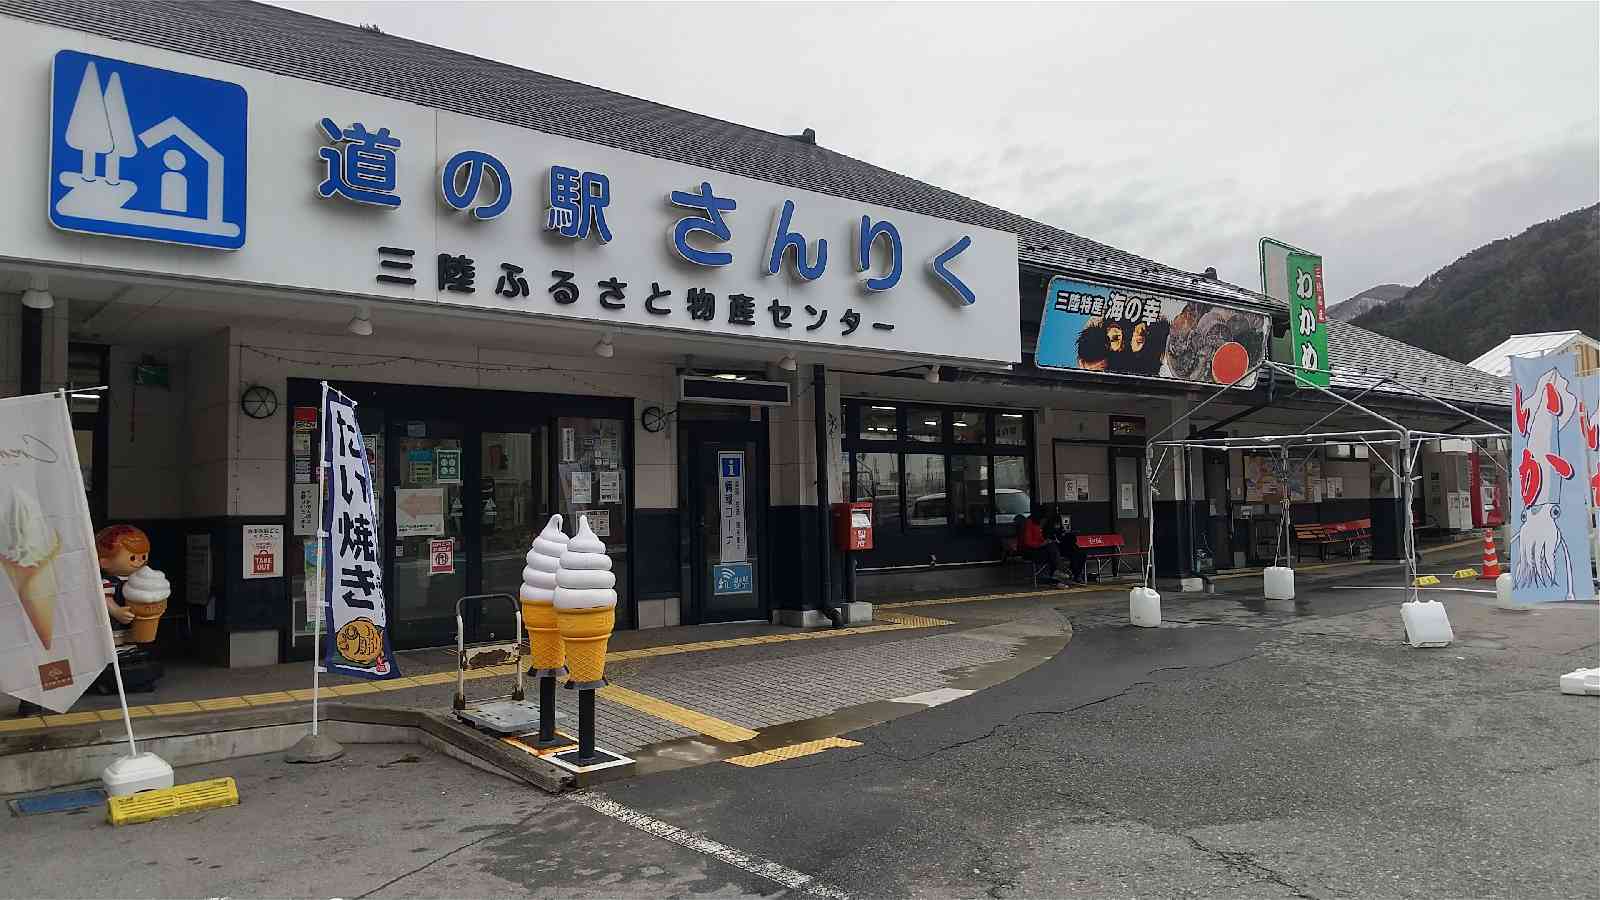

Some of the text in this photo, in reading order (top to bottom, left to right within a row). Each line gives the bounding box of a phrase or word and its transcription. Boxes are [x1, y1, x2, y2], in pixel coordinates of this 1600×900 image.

[316, 116, 977, 306] 道の駅 さんりく
[376, 246, 895, 336] 三陸ふるさと物産センター
[1055, 290, 1161, 326] 三陸特産 海の幸
[1296, 267, 1319, 374] わかめ
[1515, 383, 1575, 508] いか
[335, 409, 376, 611] たい焼き
[256, 563, 271, 571] OUT
